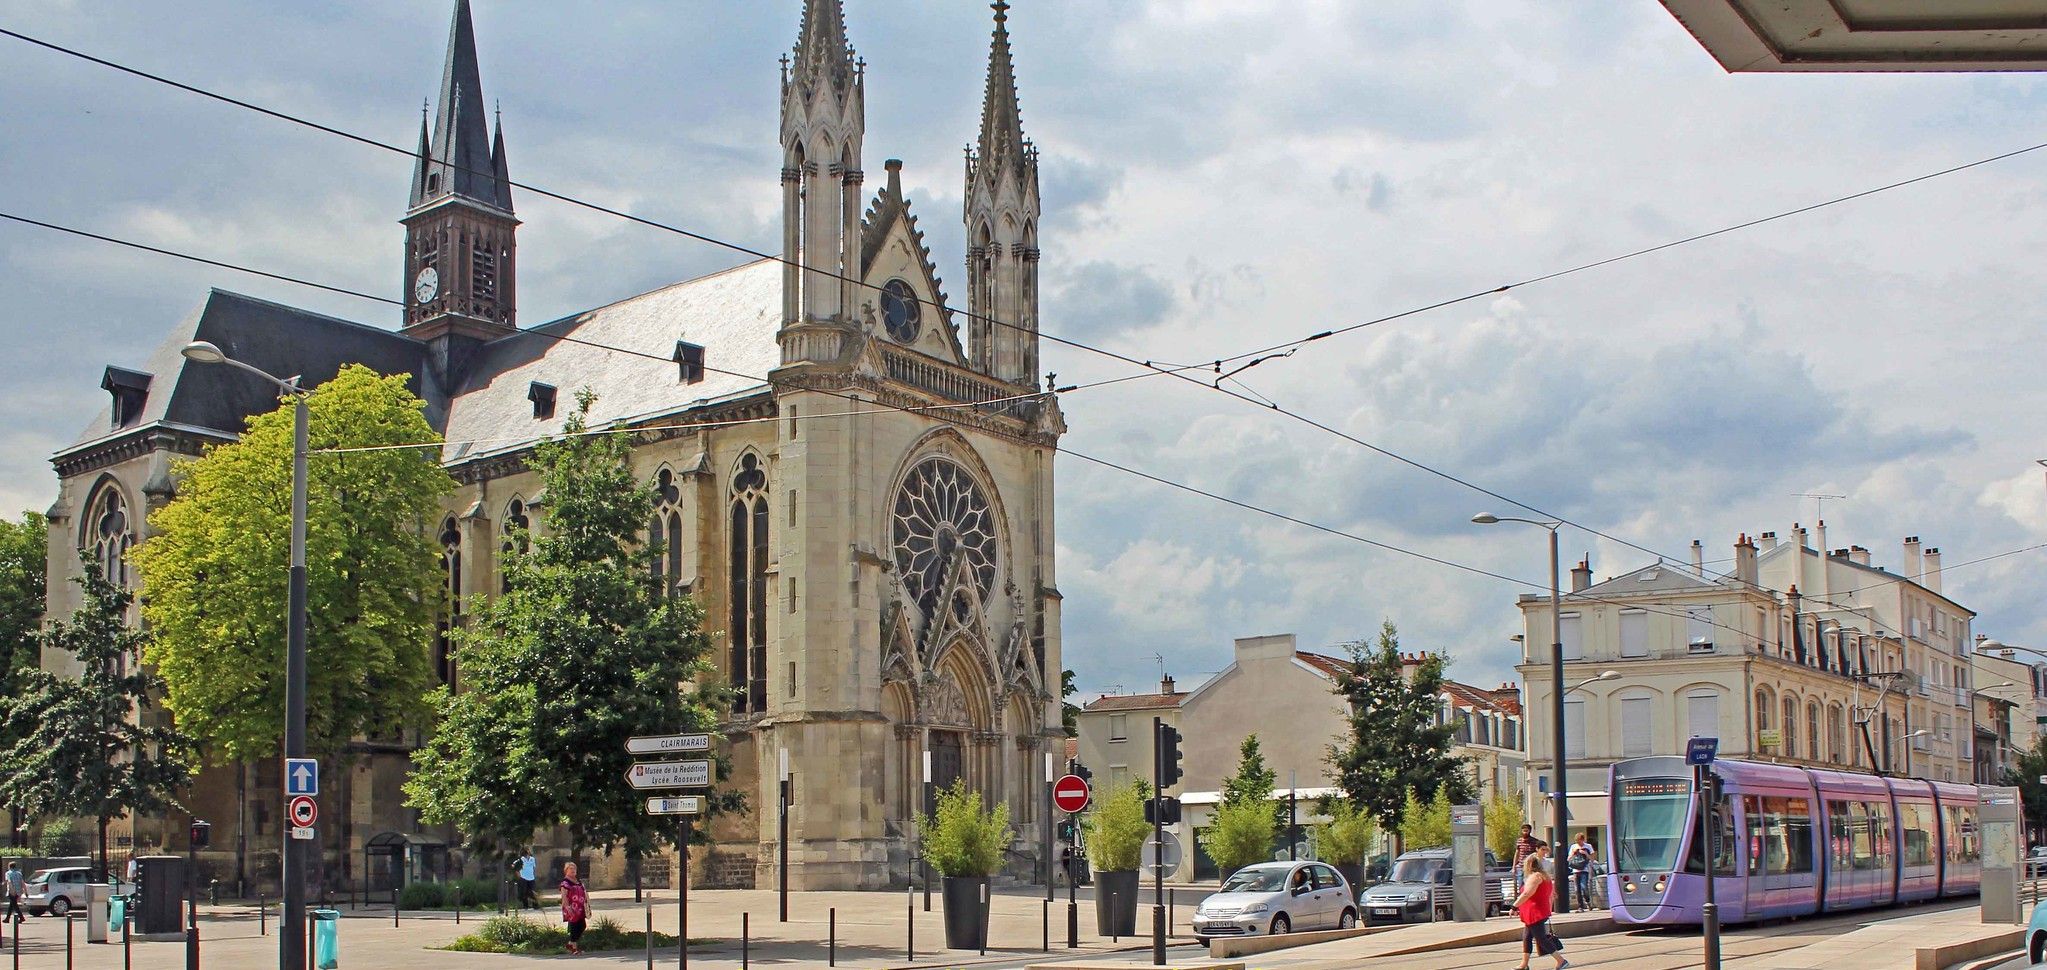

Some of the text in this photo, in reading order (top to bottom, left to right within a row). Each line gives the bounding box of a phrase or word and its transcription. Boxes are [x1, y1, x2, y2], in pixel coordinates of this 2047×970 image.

[661, 738, 707, 748] CLAIRMARAIS
[645, 767, 663, 775] Musée
[664, 766, 671, 774] de
[679, 765, 707, 773] Reddition
[652, 775, 707, 784] Lycée Roosevelt
